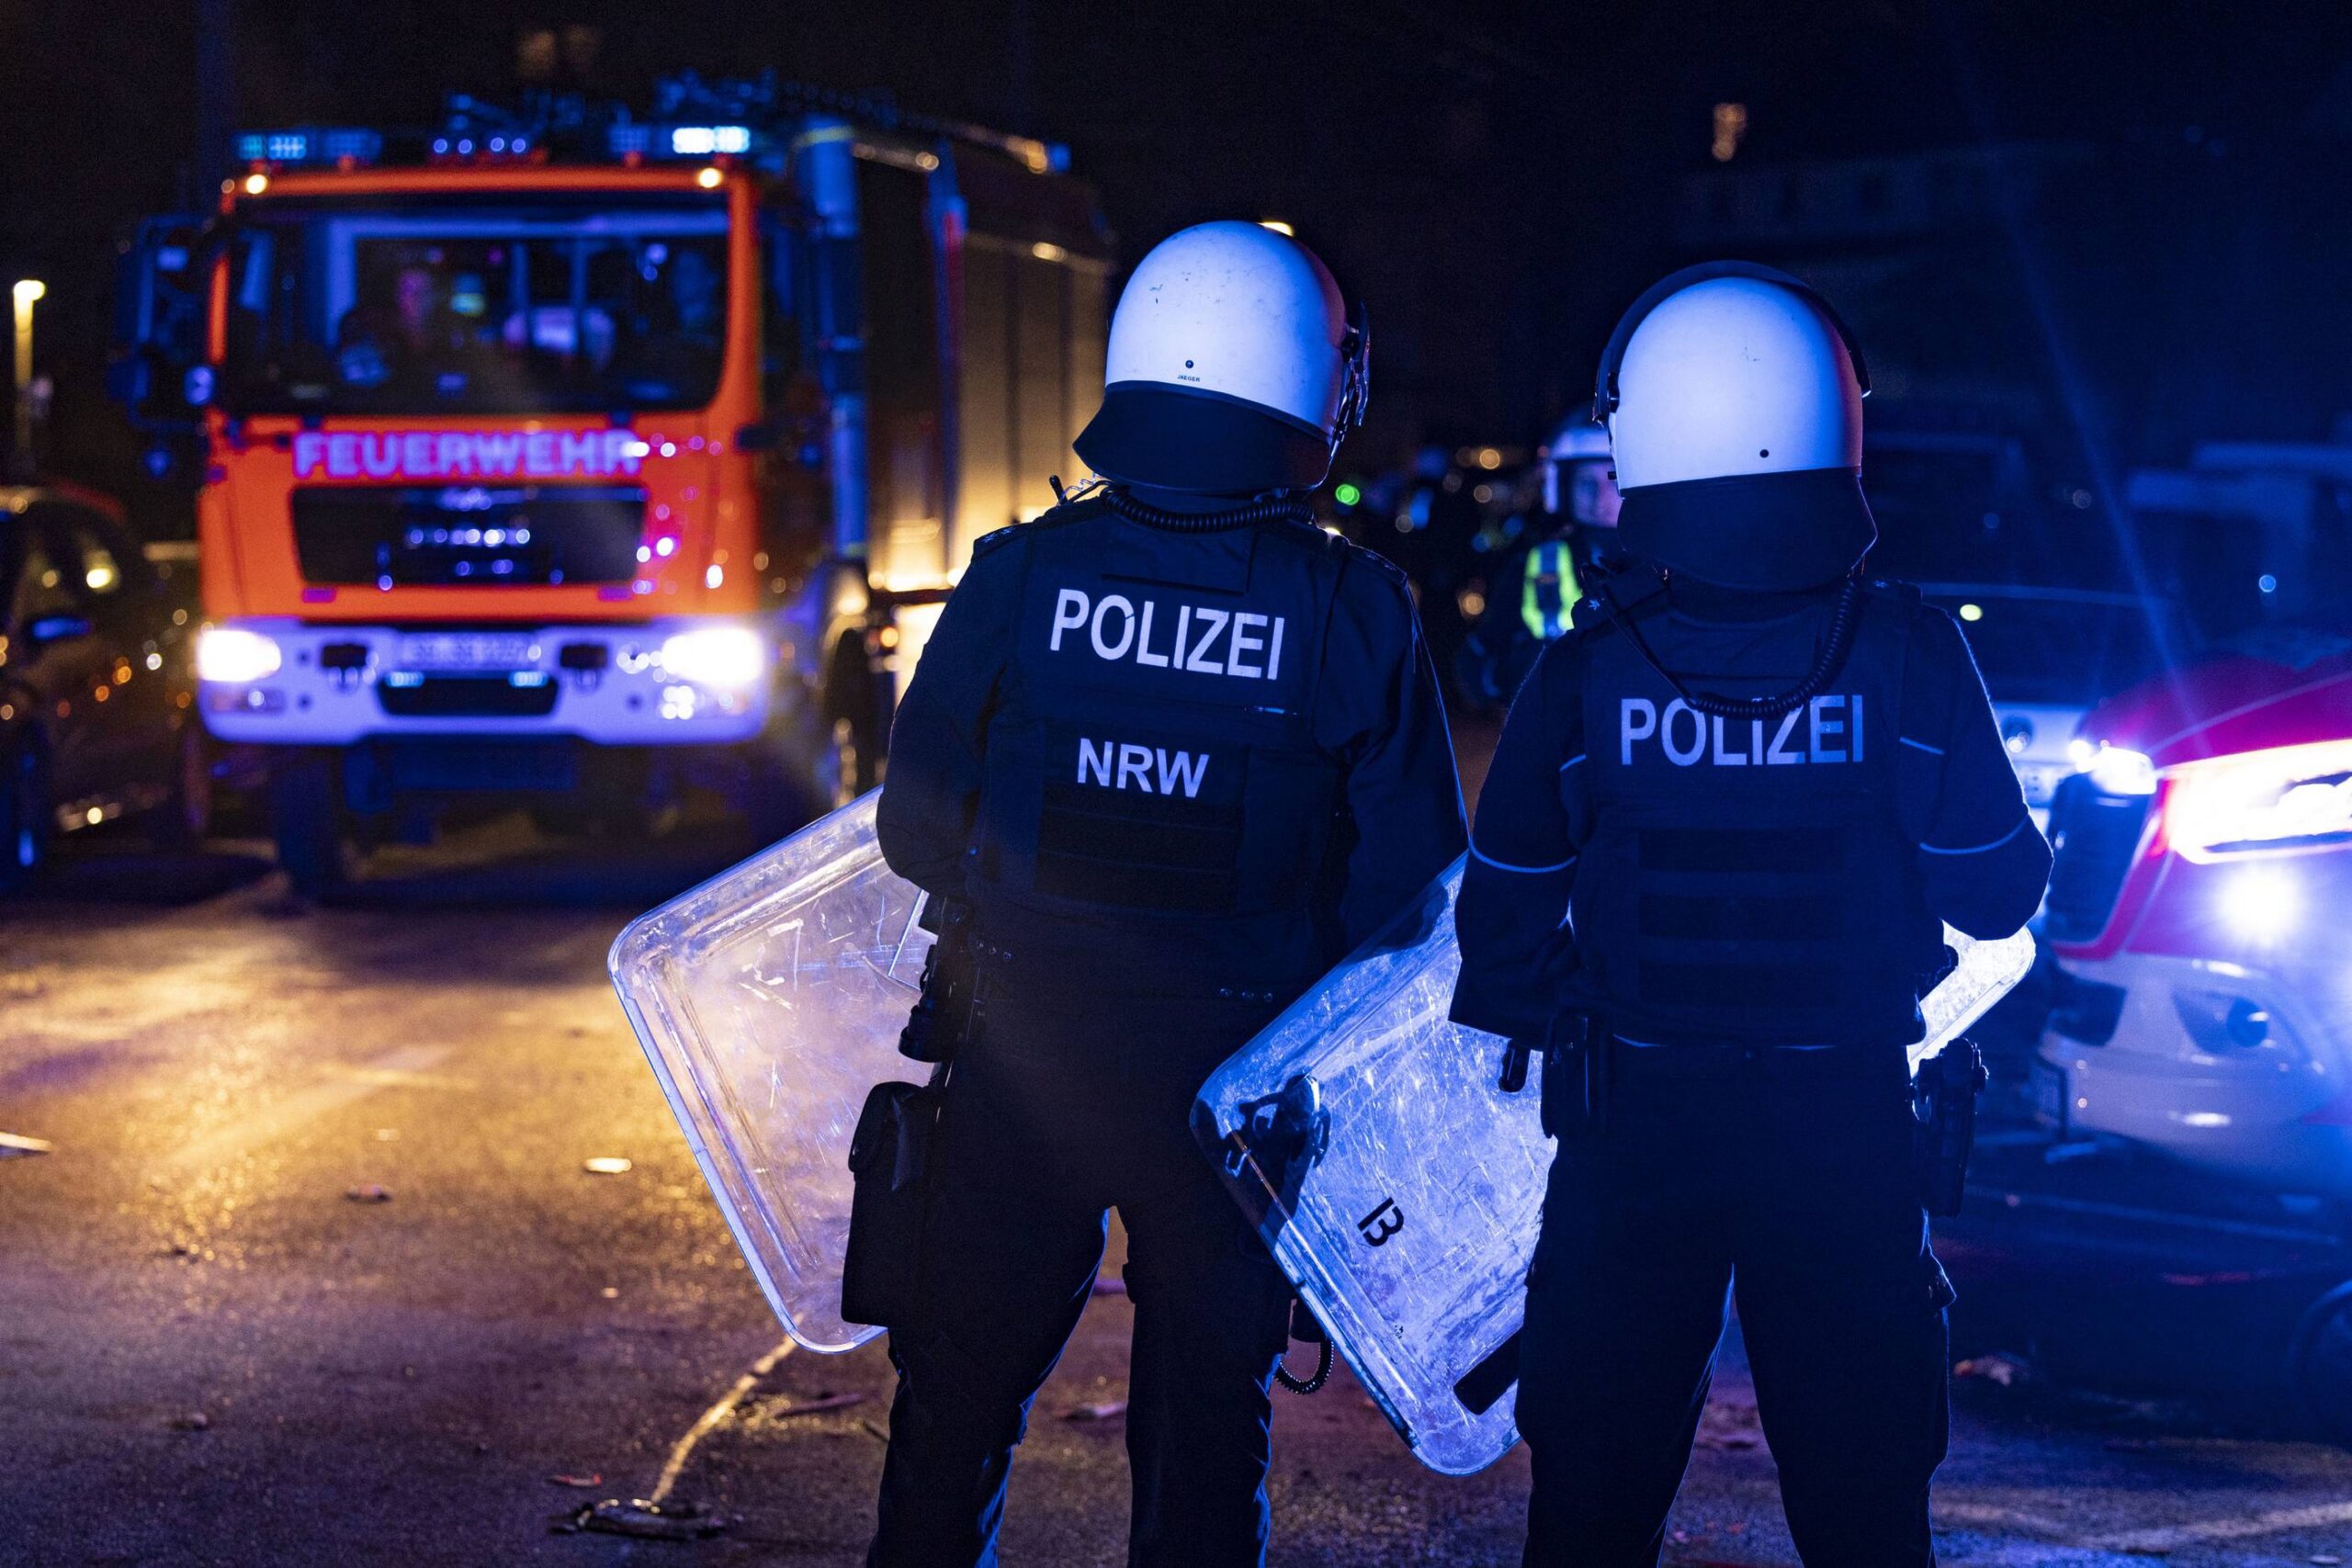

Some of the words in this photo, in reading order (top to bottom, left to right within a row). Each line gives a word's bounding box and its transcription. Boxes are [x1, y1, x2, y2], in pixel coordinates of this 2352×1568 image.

[294, 432, 640, 478] FEUERWEHR
[1050, 588, 1285, 681] POLIZEI
[1621, 694, 1863, 766] POLIZEI
[1077, 738, 1209, 798] NRW
